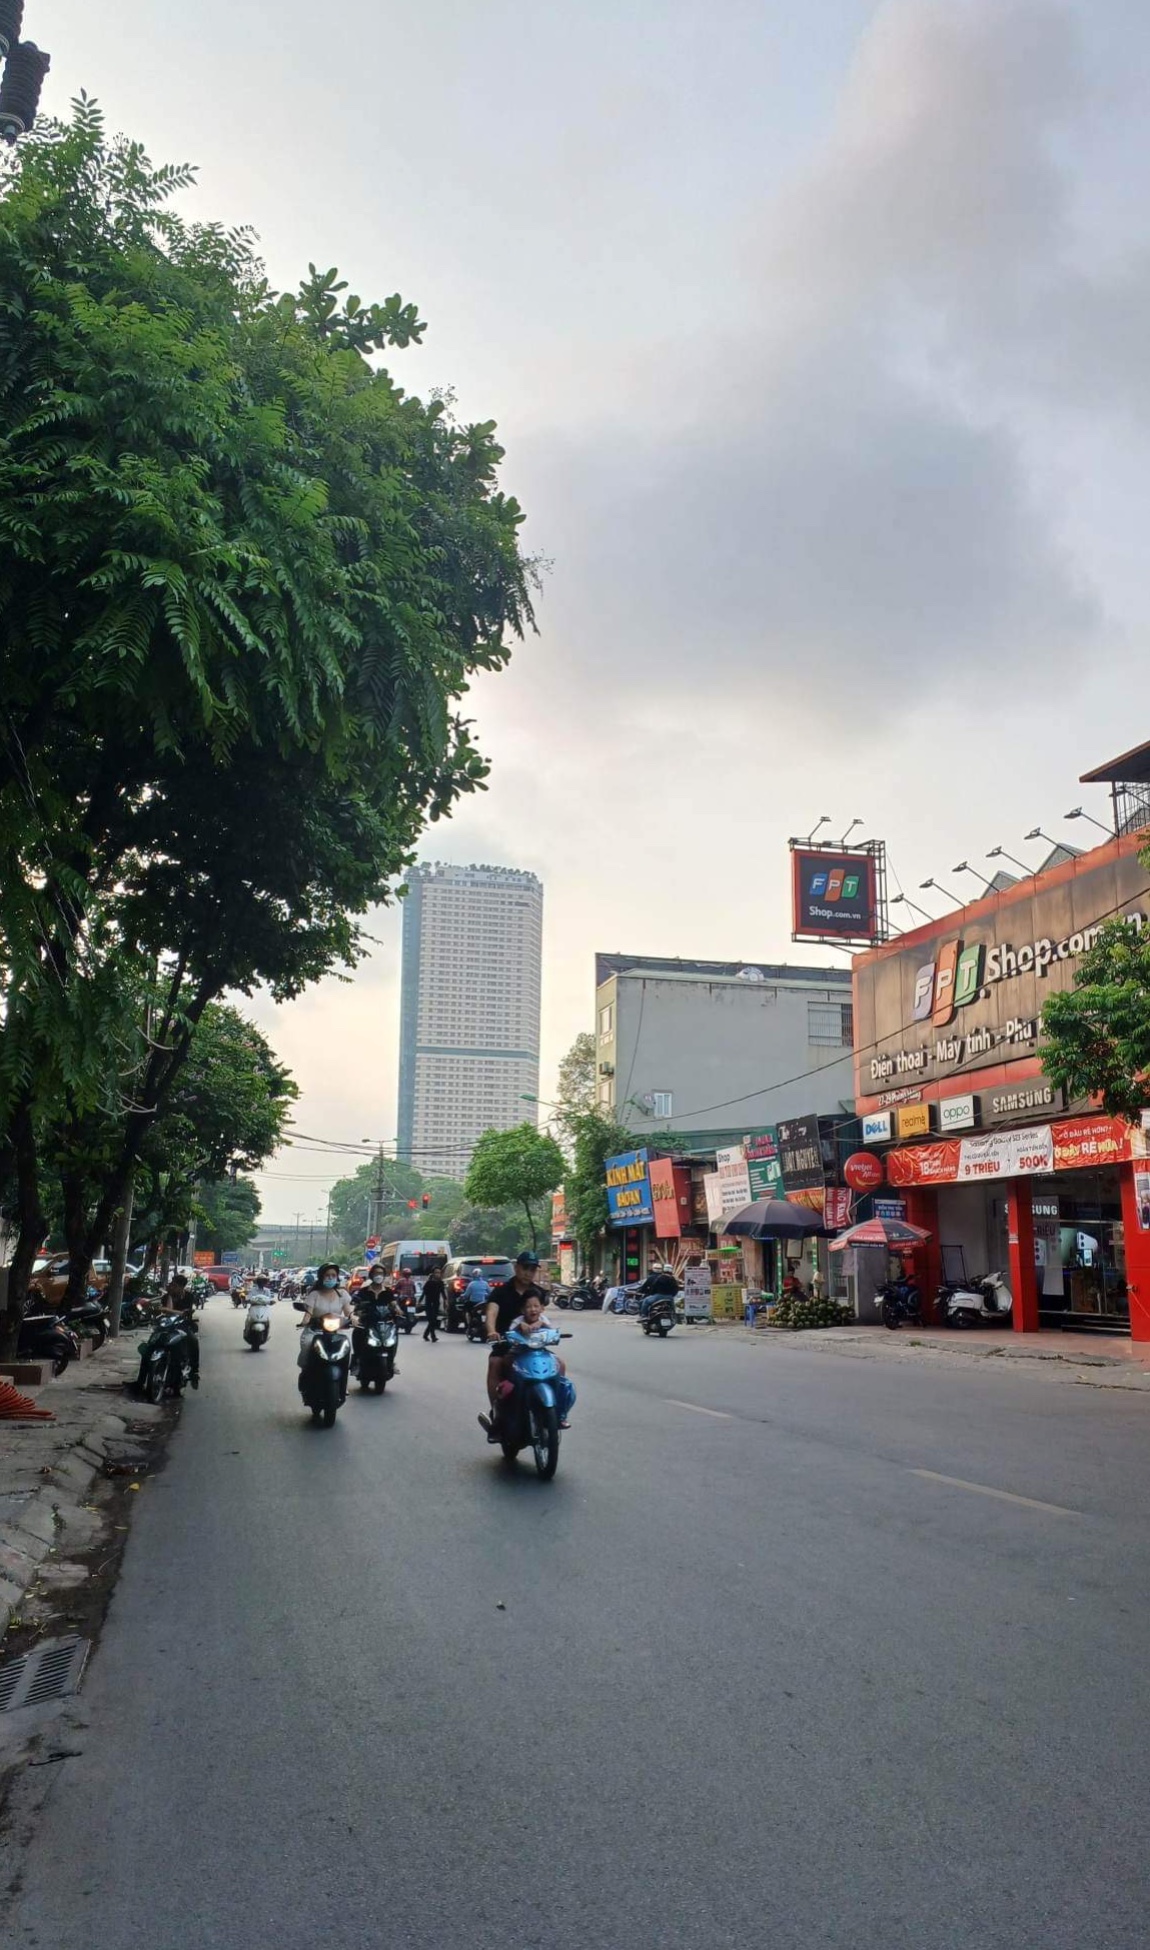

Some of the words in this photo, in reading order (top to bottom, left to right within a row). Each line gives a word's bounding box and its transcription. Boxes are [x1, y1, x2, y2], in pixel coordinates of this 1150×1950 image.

[809, 905, 861, 919] Shop.com.vn
[871, 1054, 893, 1083] Điện
[896, 1044, 924, 1075] thoại
[936, 1035, 962, 1063] Máy
[967, 1027, 991, 1052] tính
[1006, 1018, 1032, 1047] Phụ
[992, 1087, 1052, 1113] SAMSUNG
[943, 1105, 969, 1120] oppo
[865, 1120, 887, 1135] DELL
[965, 1164, 971, 1175] 9
[1019, 1155, 1048, 1169] 500K
[606, 1162, 627, 1187] KÍNH
